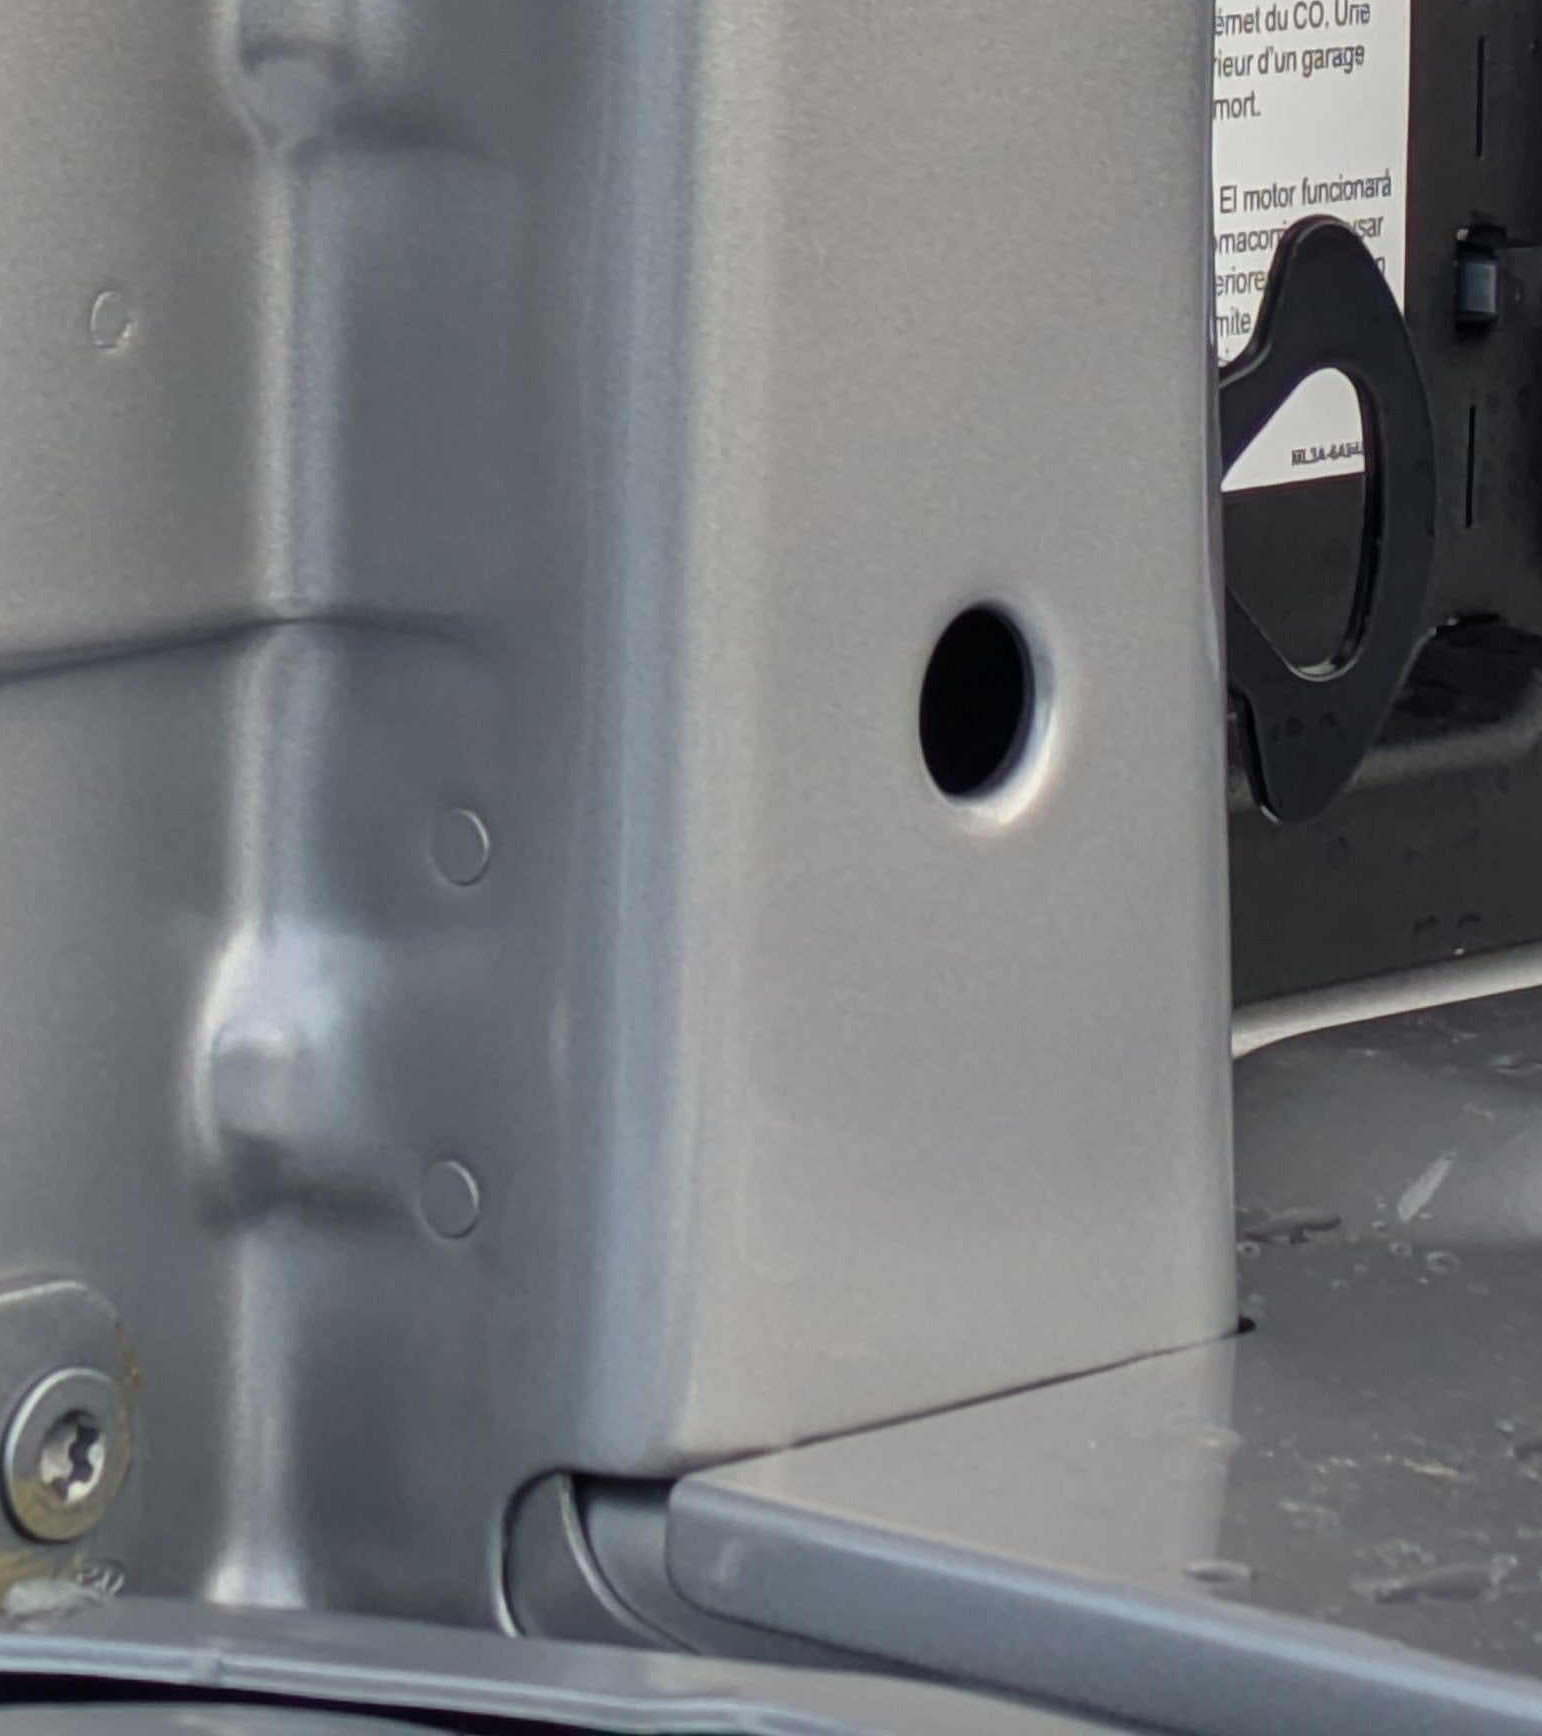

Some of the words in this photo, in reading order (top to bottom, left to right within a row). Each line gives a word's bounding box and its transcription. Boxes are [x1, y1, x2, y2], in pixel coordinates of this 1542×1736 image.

[1265, 3, 1288, 32] du
[1258, 45, 1297, 74] d'un
[1302, 45, 1365, 78] garage
[1219, 184, 1237, 214] El
[1244, 182, 1296, 212] motor
[1301, 168, 1391, 205] funcionará
